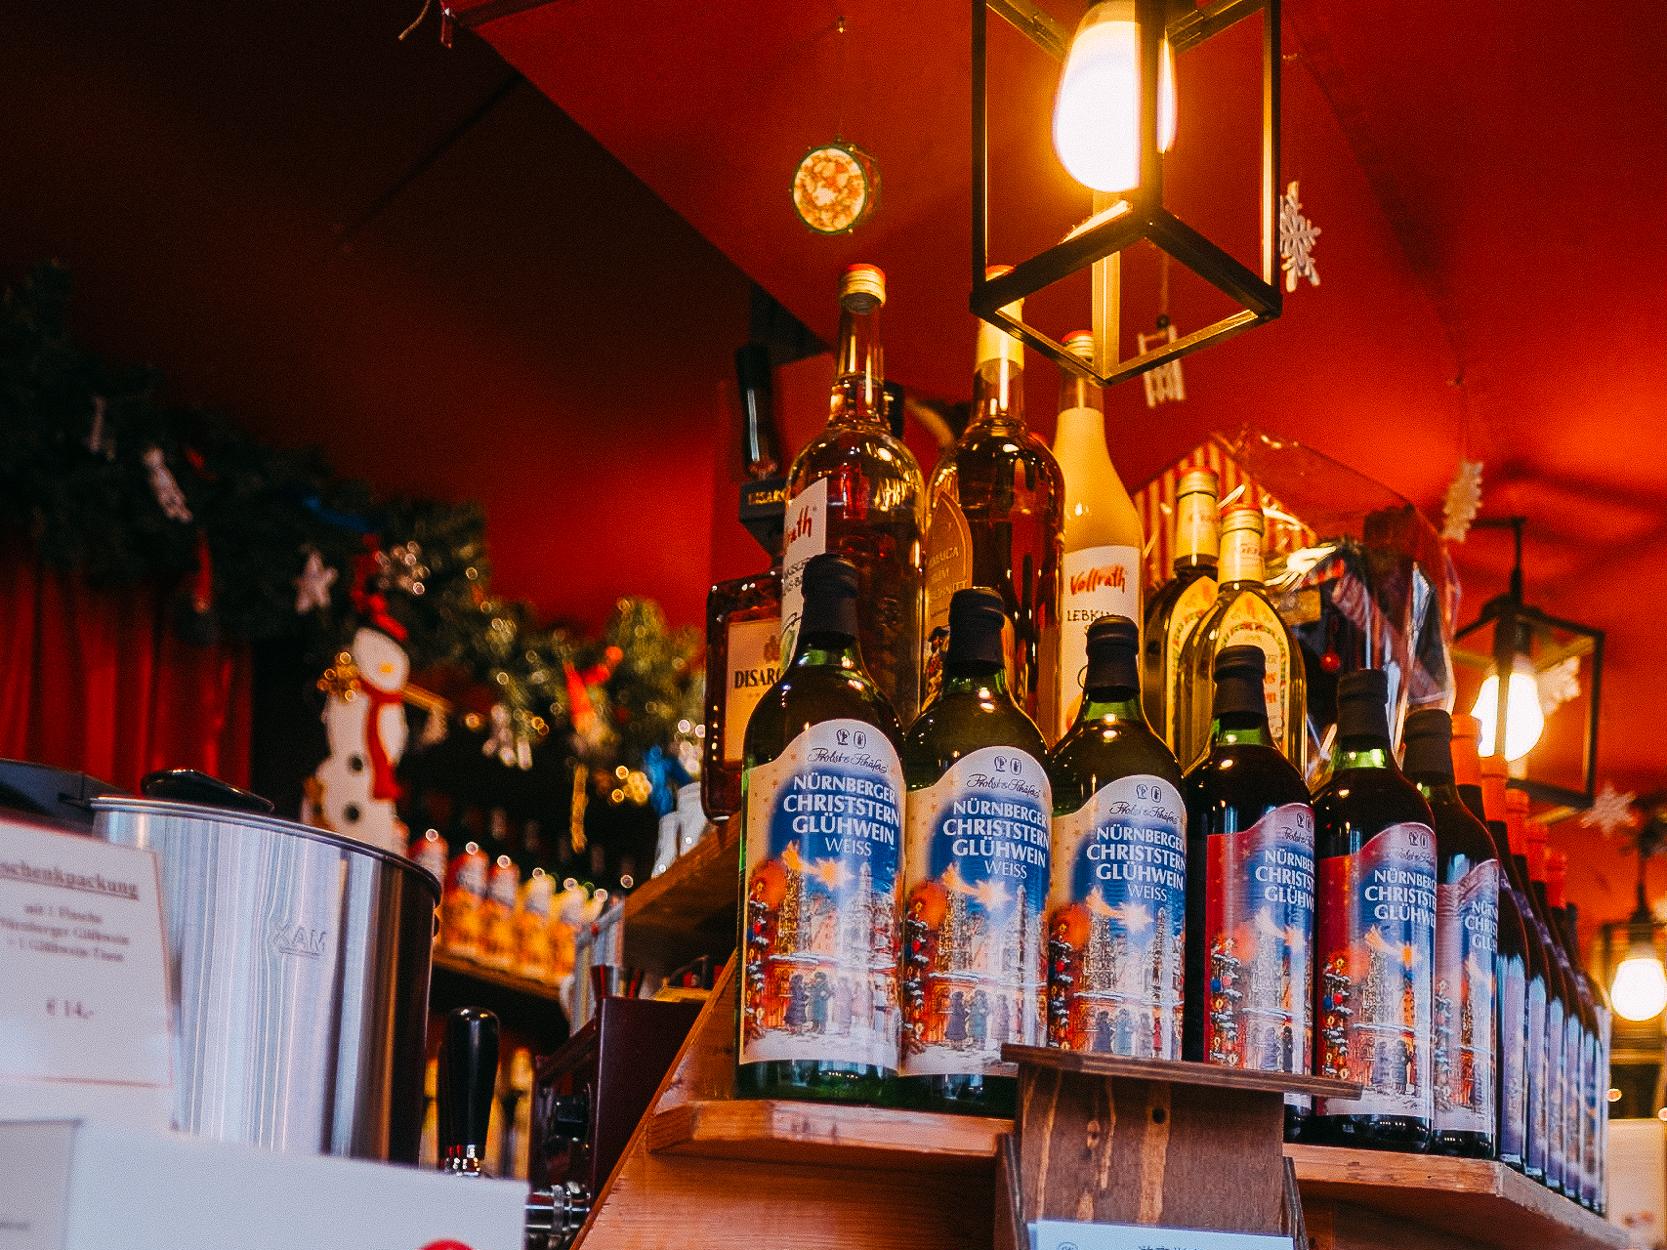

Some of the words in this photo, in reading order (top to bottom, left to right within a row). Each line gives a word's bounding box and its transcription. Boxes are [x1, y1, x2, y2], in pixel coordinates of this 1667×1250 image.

[793, 772, 897, 805] NÜRNBERGER
[783, 794, 900, 828] CHRISTSTERN
[953, 798, 1048, 829] NÜRNBERGER
[792, 812, 895, 845] GLÜHWEIN
[942, 818, 1050, 851] CHRISTSTERN
[825, 837, 872, 857] WEISS
[952, 836, 1046, 869] GLÜHWEIN
[984, 860, 1028, 880] WEISS
[1096, 861, 1184, 891] GLÜHWEIN
[1127, 882, 1168, 902] WEISS
